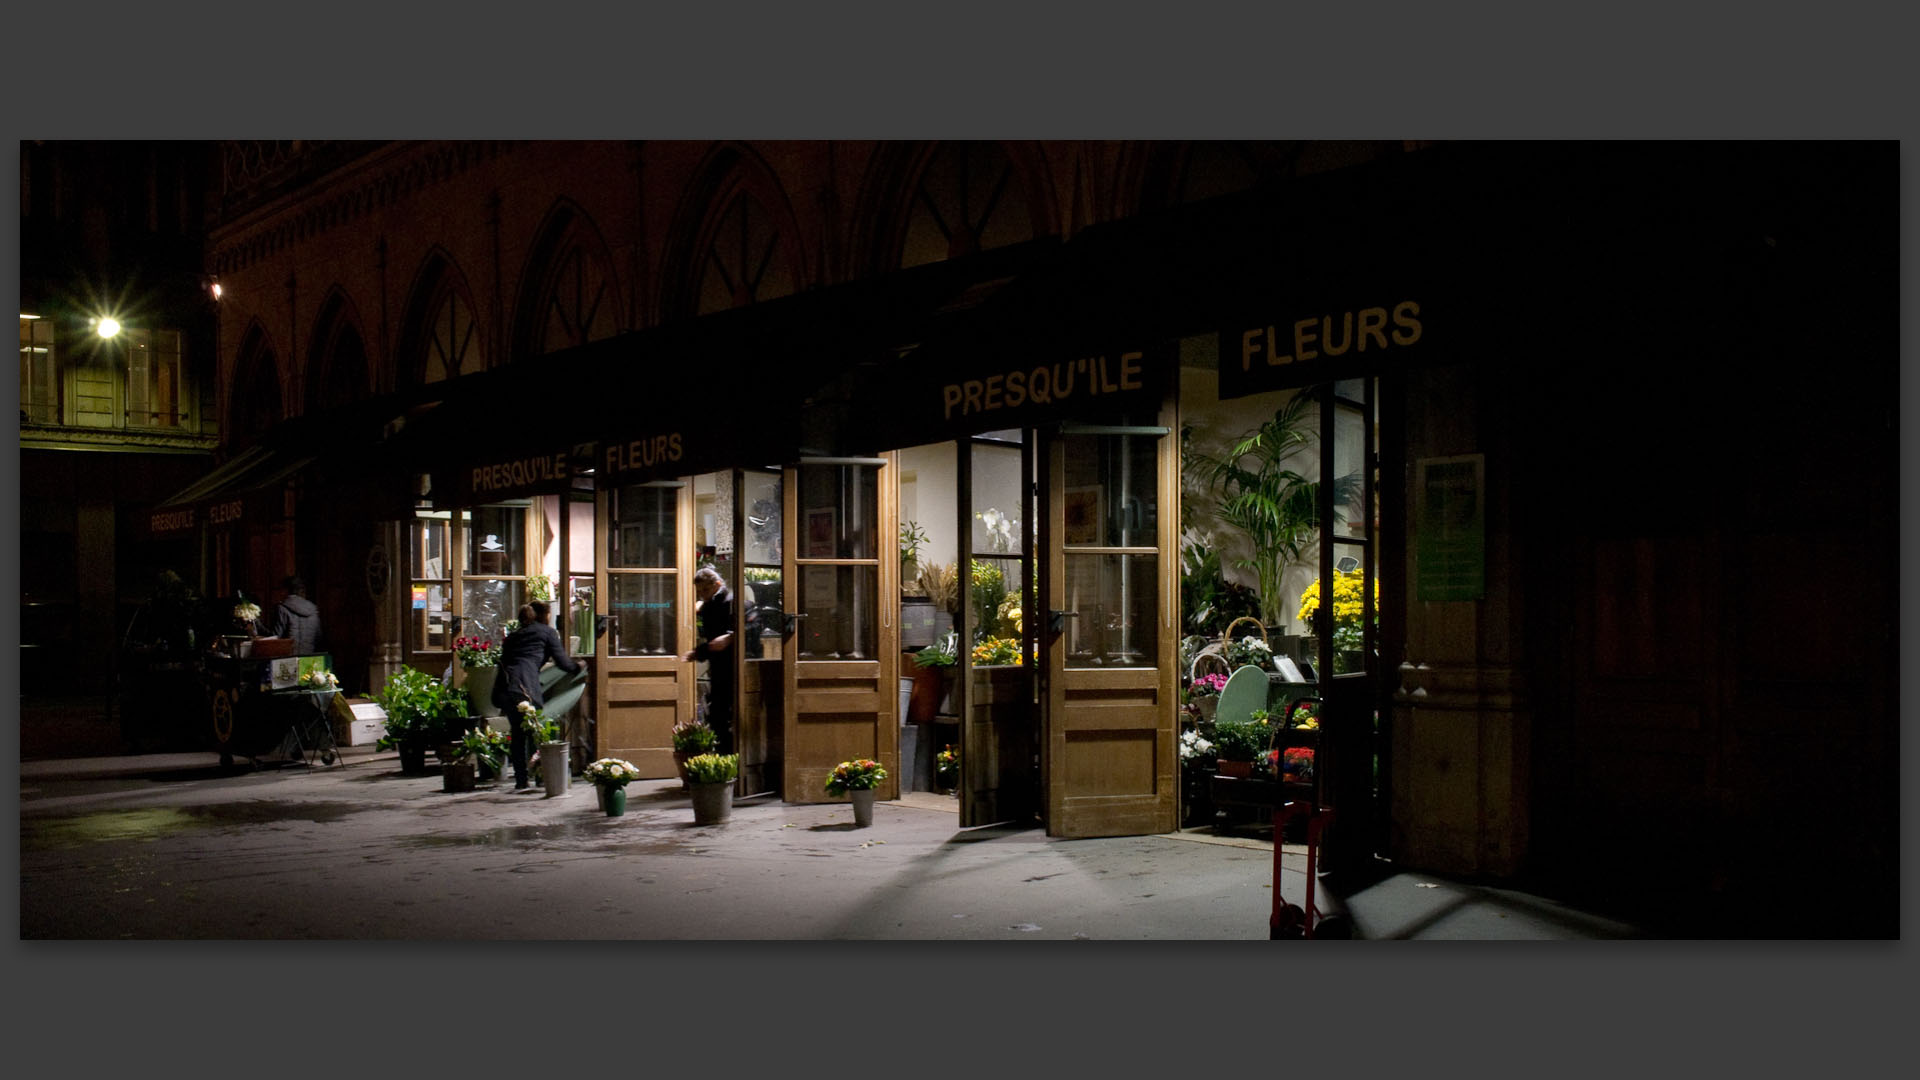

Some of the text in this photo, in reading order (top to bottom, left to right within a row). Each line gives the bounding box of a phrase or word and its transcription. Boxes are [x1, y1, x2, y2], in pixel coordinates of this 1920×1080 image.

[1241, 300, 1424, 373] FLEURS
[942, 351, 1144, 421] PRESQU'ILE
[471, 432, 684, 493] PRESQU'ILE FLEURS
[209, 500, 242, 524] FLEURS
